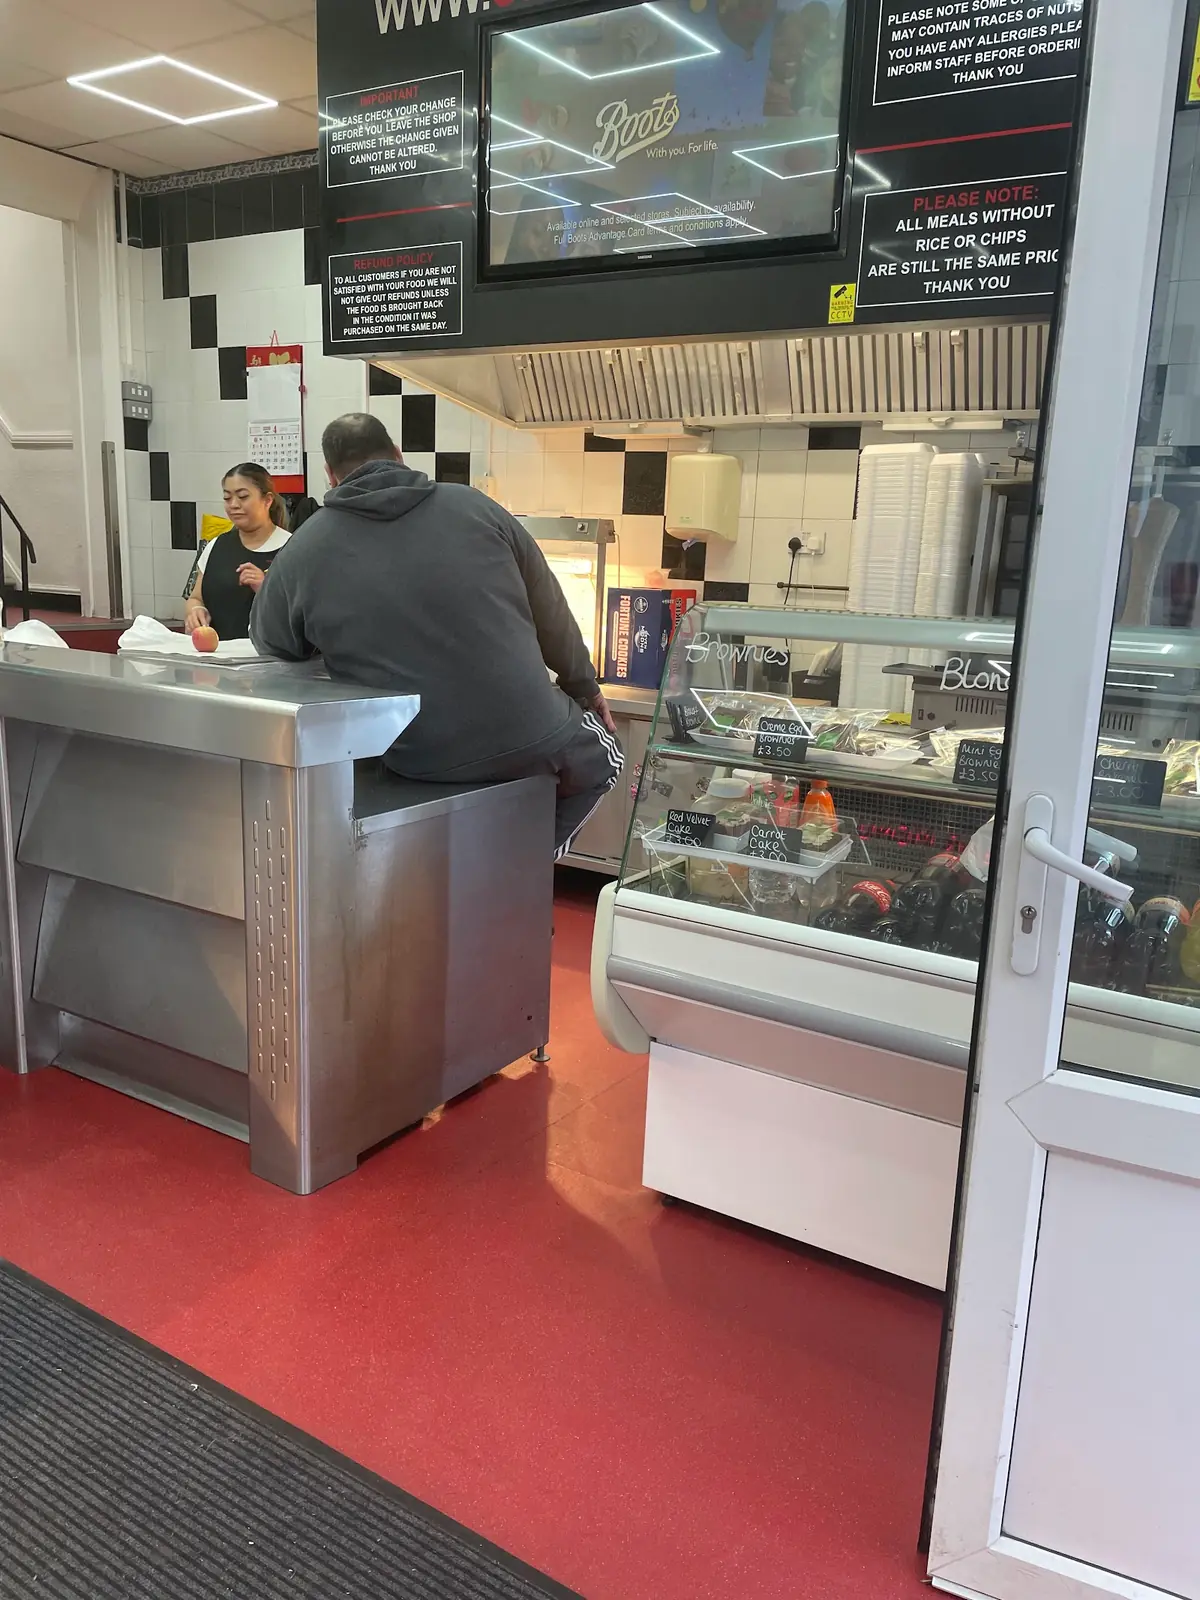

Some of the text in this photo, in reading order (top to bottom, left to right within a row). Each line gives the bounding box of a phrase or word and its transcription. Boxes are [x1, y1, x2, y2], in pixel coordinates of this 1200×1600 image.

[888, 0, 1007, 26] PLEASE NOTE SOME
[892, 28, 916, 42] MAY
[918, 19, 970, 37] CONTAIN
[974, 10, 1023, 28] TRACES
[1026, 6, 1044, 19] OF
[888, 47, 912, 60] YOU
[915, 41, 947, 56] HAVE
[949, 36, 975, 51] ANY
[977, 26, 1047, 46] ALLERGIES
[887, 38, 1081, 77] INFORM STAFF BEFORE ORDERI
[953, 63, 1024, 84] THANK YOU
[361, 86, 419, 106] IMPORTANT
[333, 97, 456, 126] PLEASE CHECK YOUR CHANGE
[332, 111, 457, 141] BEFORE YOU LEAVE THE SHOP
[585, 92, 680, 163] Boots
[331, 125, 459, 154] OTHERWISE THE CHANGE GIVEN
[646, 148, 667, 158] With
[688, 142, 702, 153] For
[703, 139, 719, 151] life.
[350, 143, 437, 165] CANNOT BE ALTERED.
[370, 160, 417, 175] THANK YOU
[913, 185, 1039, 212] PLEASE NOTE:
[546, 221, 577, 232] Available
[578, 218, 599, 228] online
[601, 215, 614, 226] and
[674, 205, 702, 217] Subject
[713, 199, 756, 214] availability.
[895, 204, 1056, 233] ALL MEALS WITHOUT
[567, 233, 587, 244] Boots
[589, 230, 626, 241] Advantage
[627, 227, 645, 237] Card
[669, 223, 684, 233] and
[685, 218, 724, 232] conditions
[915, 229, 1027, 252] RICE OR CHIPS
[354, 253, 434, 270] REFUND POLICY
[867, 263, 897, 278] ARE
[900, 259, 940, 275] STILL
[944, 256, 973, 271] THE
[977, 252, 1021, 268] SAME
[335, 265, 457, 285] TO ALL CUSTOMERS IF YOU ARE NOT
[923, 275, 1011, 294] THANK YOU
[333, 277, 457, 295] SATISFIED WITH YOUR FOOD WE WILL
[340, 288, 449, 305] NOT GIVE OUT REFUNDS UNLESS
[346, 299, 444, 315] THE FOOD IS BROUGHT BACK
[831, 311, 852, 319] CCTV
[352, 311, 437, 325] IN THE CONDITION IT WAS
[343, 321, 448, 336] PURCHASED ON THE SAME DAY.
[619, 595, 631, 636] FORTUNE
[616, 637, 629, 678] COOKIES
[686, 632, 789, 666] Brownies
[788, 722, 803, 735] Egg
[758, 745, 791, 757] £3.50
[959, 768, 999, 782] £3.50
[667, 822, 692, 834] Cake
[669, 811, 711, 827] Red Velvet
[751, 825, 787, 840] Carrot
[749, 838, 780, 852] Cake
[750, 850, 787, 863] £300
